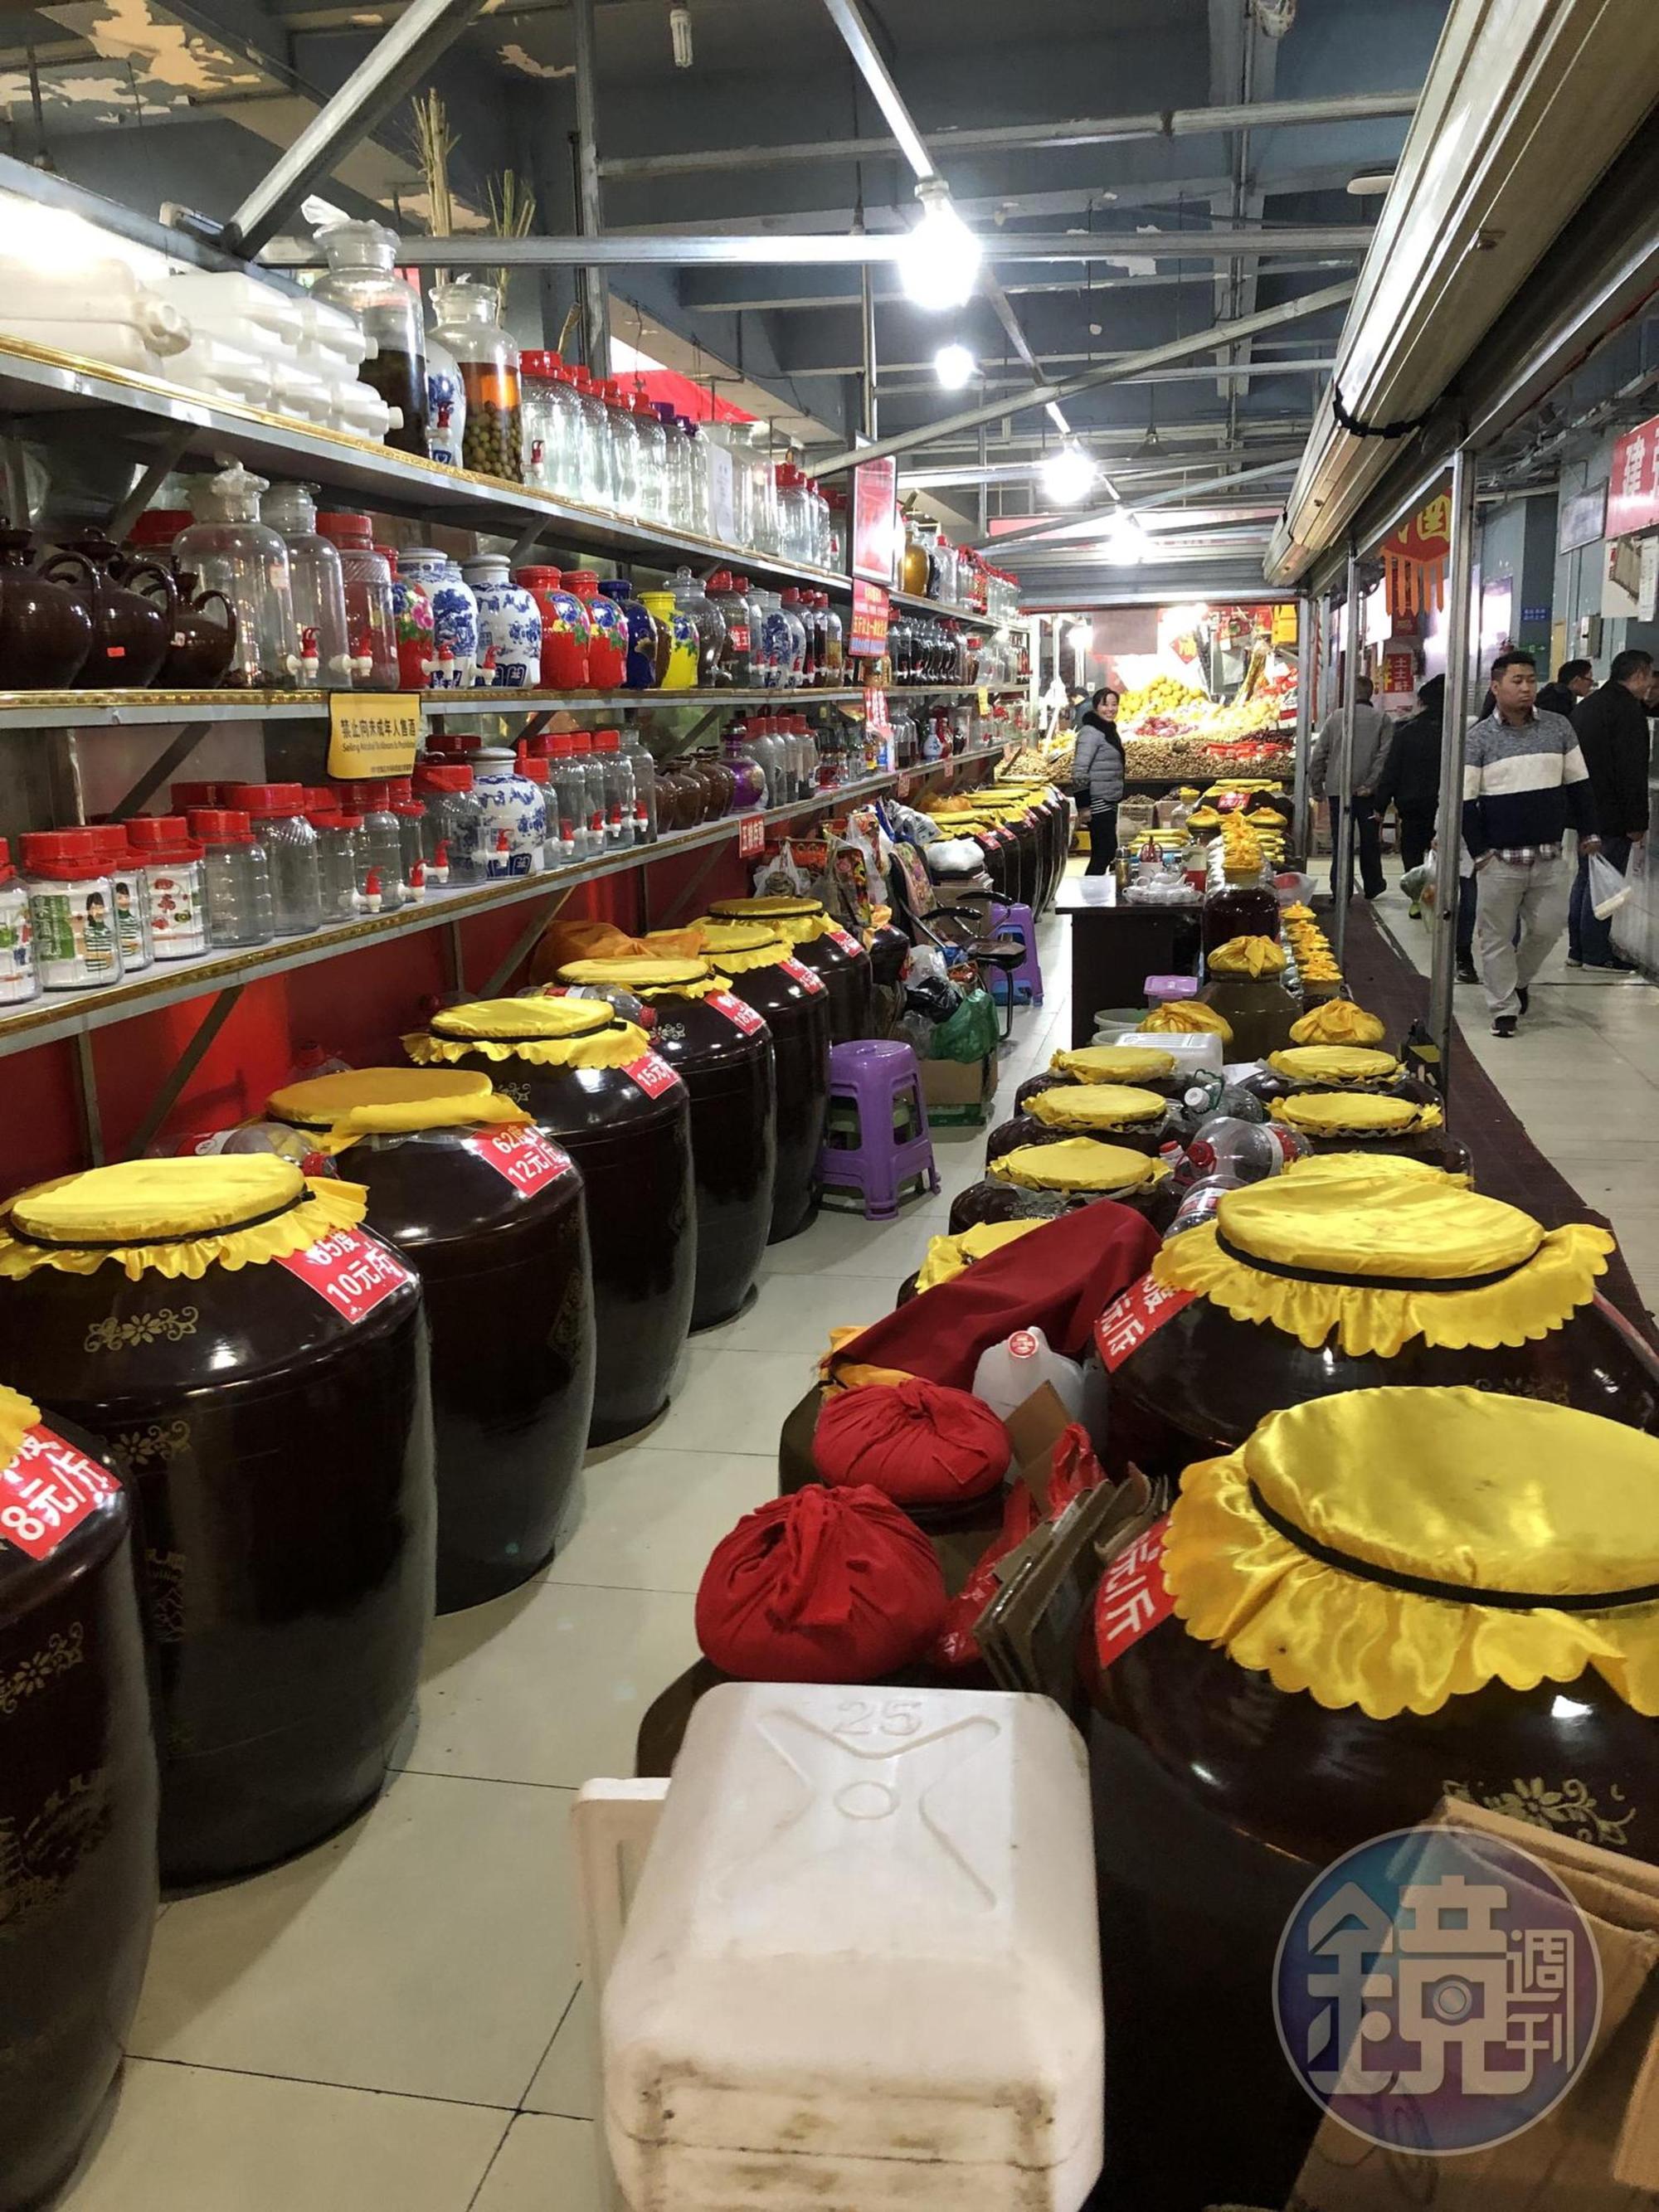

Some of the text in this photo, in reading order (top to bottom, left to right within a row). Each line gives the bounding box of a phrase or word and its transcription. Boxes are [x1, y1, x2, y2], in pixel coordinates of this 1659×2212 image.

[340, 718, 416, 739] 禁止向未成年人售酒
[833, 1700, 922, 1737] 25
